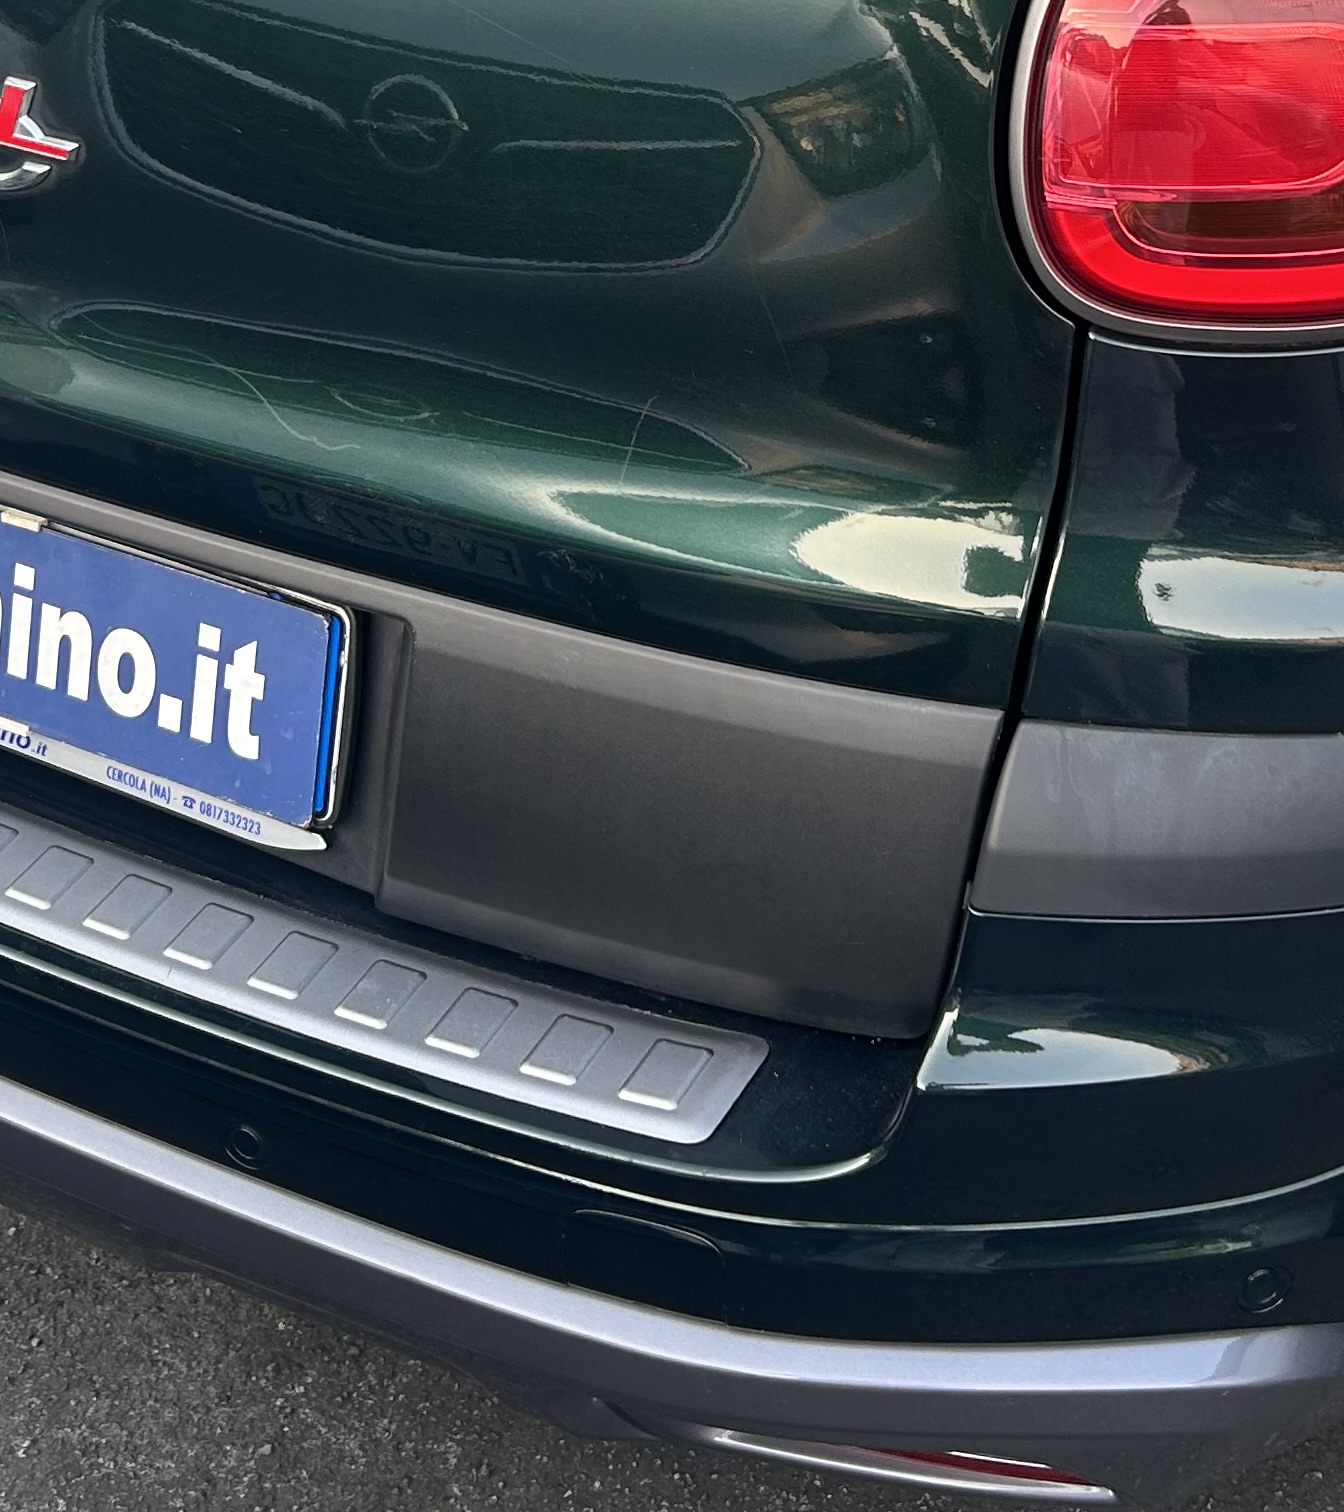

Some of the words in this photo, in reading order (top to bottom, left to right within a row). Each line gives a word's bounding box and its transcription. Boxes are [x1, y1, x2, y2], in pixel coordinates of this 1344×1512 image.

[106, 765, 147, 793] CERCOLA
[149, 780, 172, 805] (NA)
[199, 801, 261, 835] 0817332323
